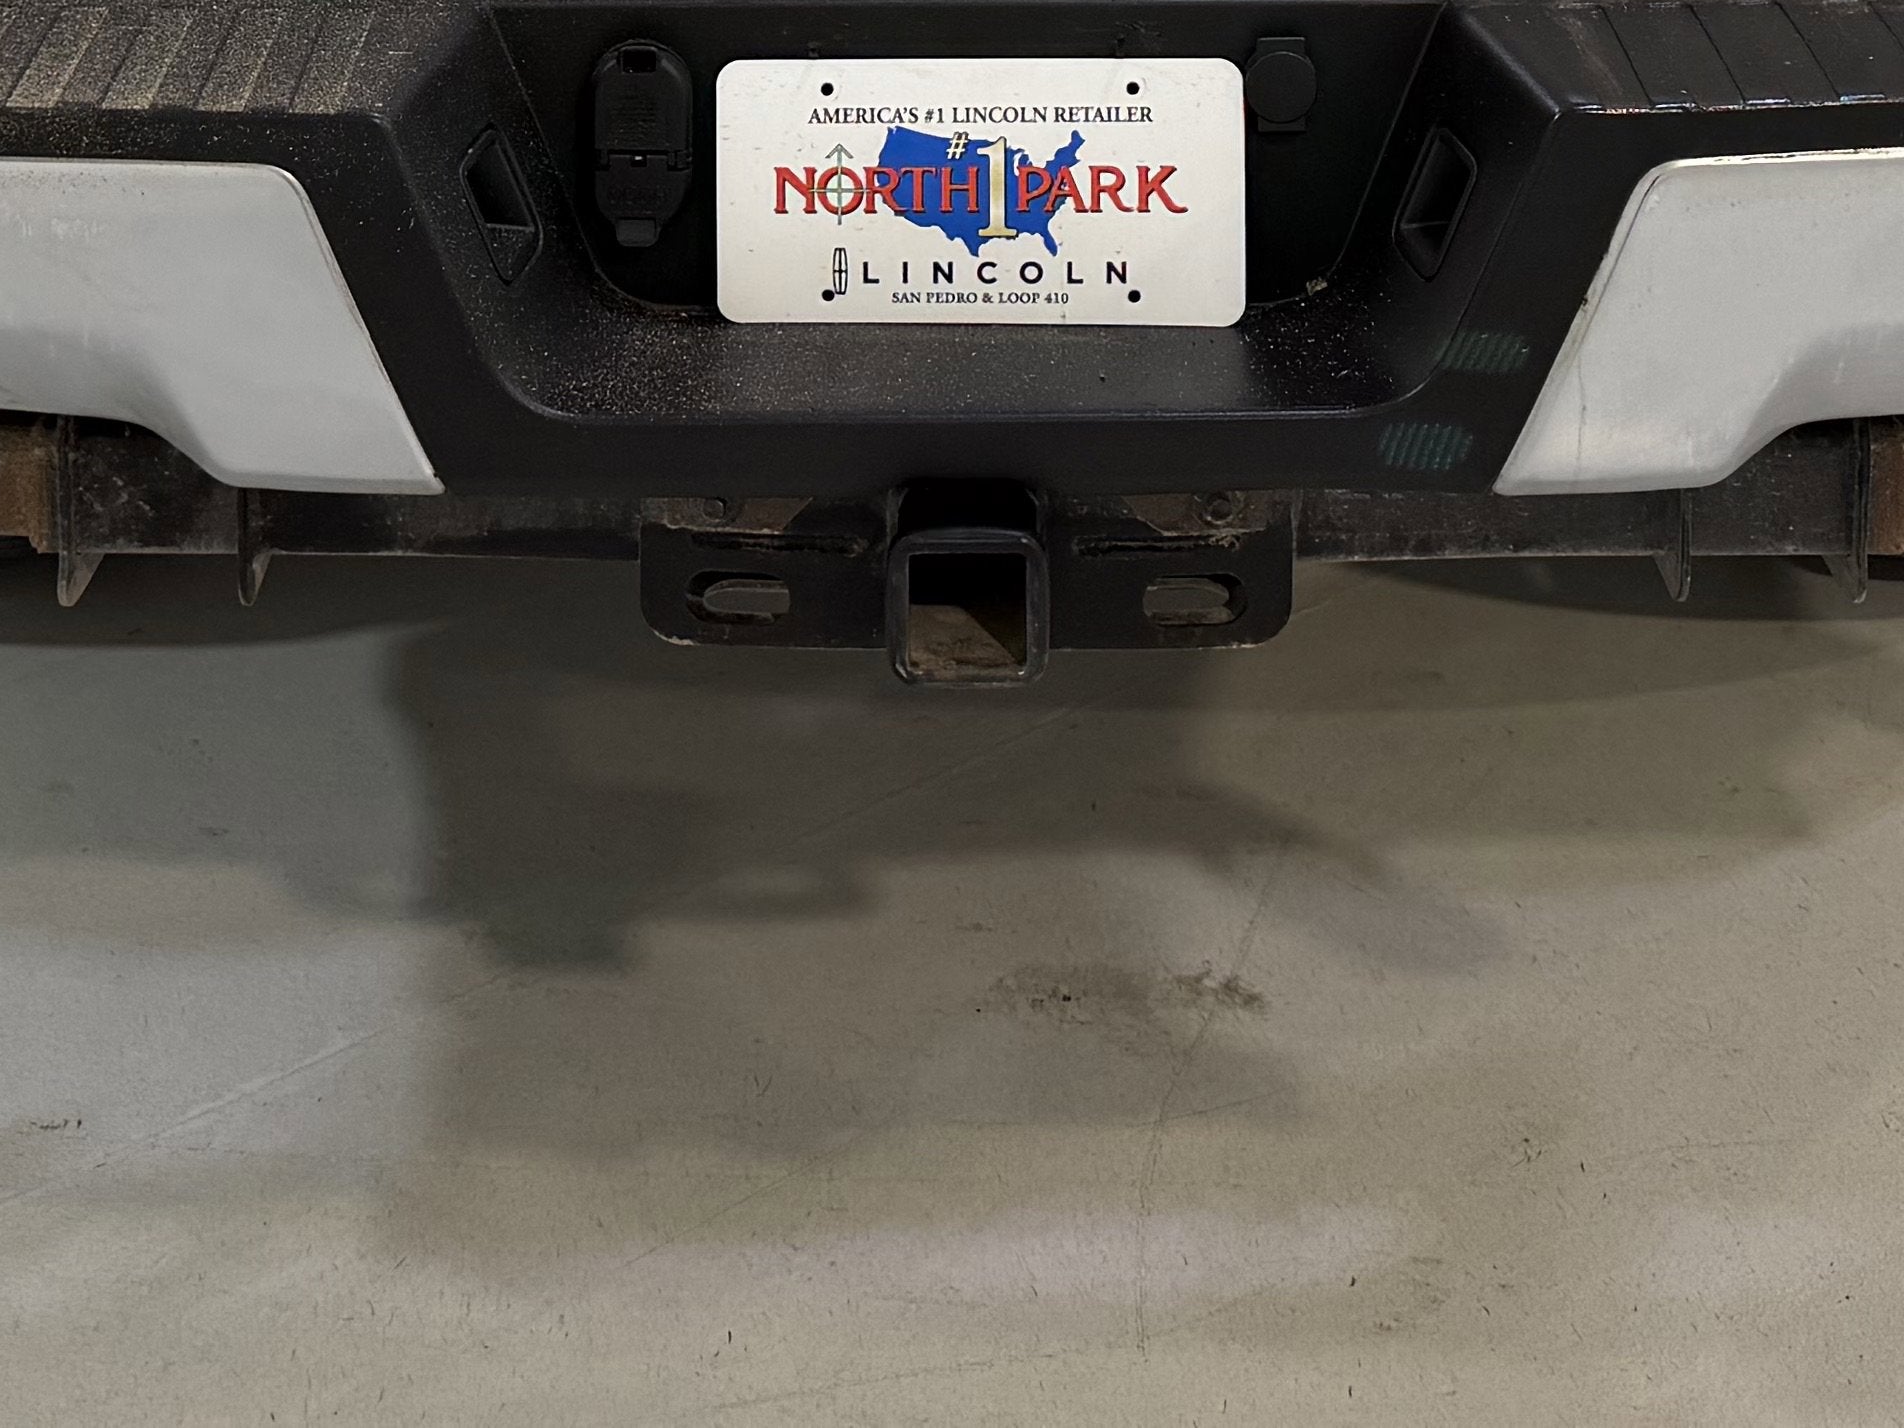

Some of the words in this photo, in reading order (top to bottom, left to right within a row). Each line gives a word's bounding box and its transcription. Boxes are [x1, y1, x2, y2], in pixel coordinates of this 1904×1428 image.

[808, 107, 919, 124] AMERICA'S
[924, 107, 944, 124] #1
[952, 106, 1048, 124] LINCOLN
[1053, 106, 1154, 123] RETAILER
[774, 165, 980, 215] NORTH
[1016, 165, 1188, 213] PARK
[862, 261, 1128, 285] LINCOLN
[891, 291, 921, 304] SAN
[926, 291, 978, 304] PEDRO
[981, 292, 994, 304] &
[998, 291, 1041, 305] LOOP
[1043, 292, 1069, 305] 410
